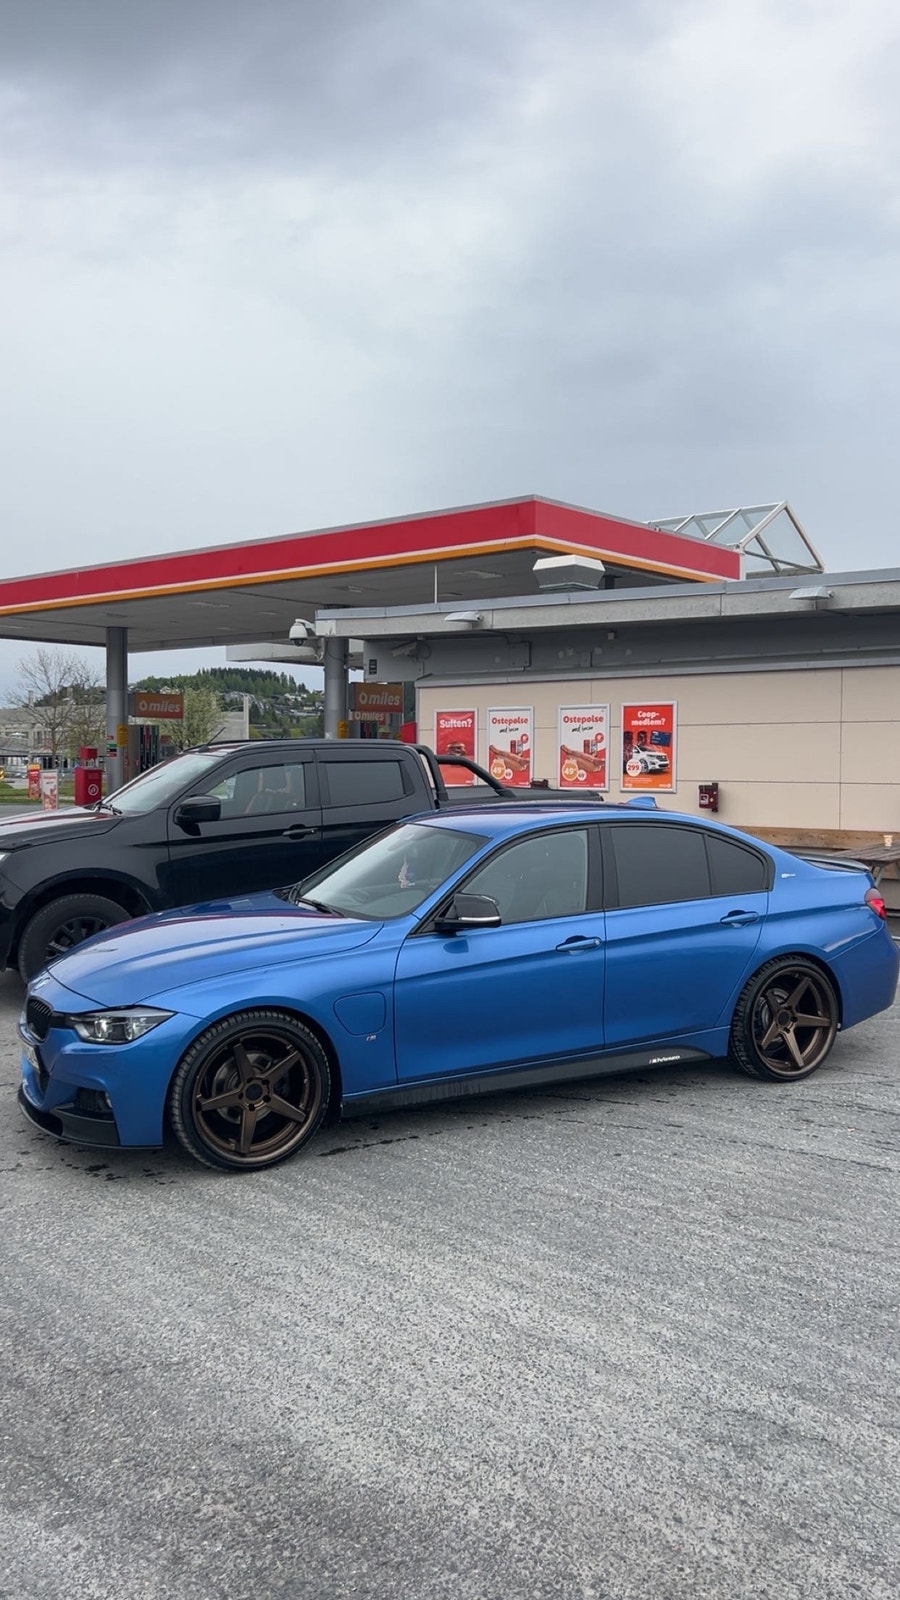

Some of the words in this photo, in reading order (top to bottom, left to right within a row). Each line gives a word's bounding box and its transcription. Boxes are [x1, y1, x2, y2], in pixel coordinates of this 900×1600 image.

[637, 710, 660, 719] Coop-
[439, 718, 473, 729] Sulten?
[631, 718, 666, 726] medlem?
